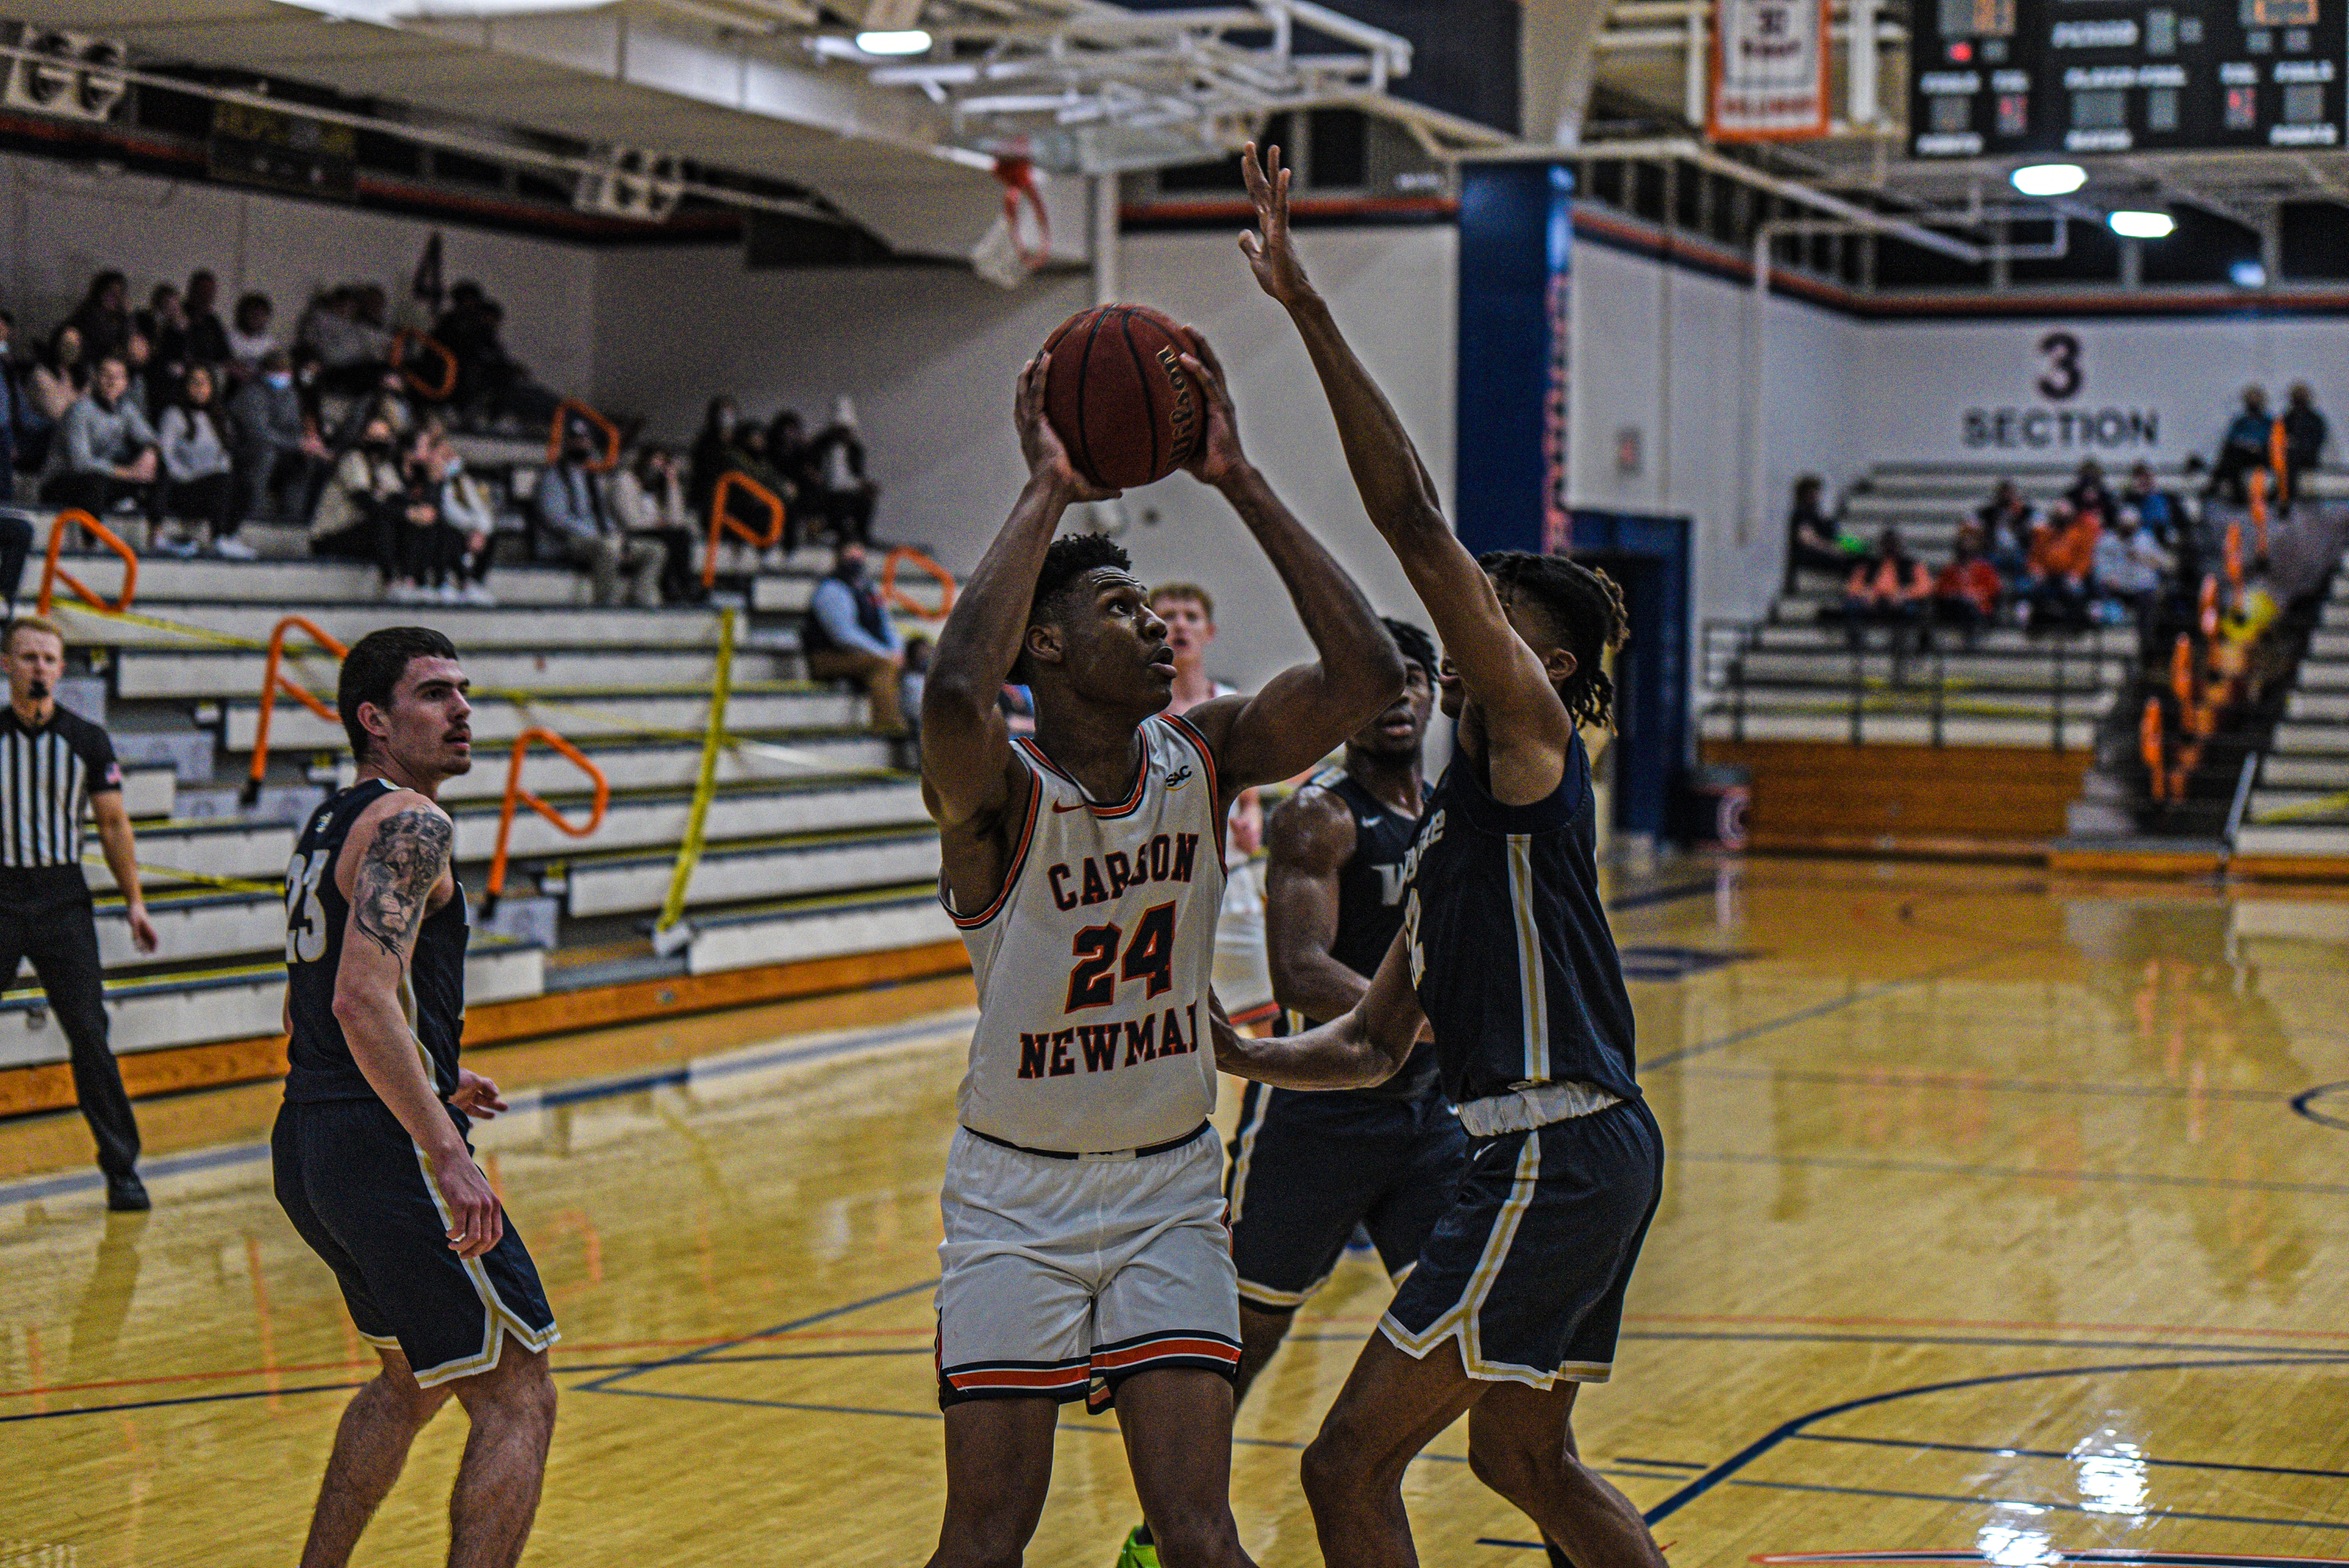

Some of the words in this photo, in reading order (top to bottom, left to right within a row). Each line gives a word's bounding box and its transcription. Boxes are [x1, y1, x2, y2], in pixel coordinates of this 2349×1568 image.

[2037, 331, 2083, 402] 3
[1962, 406, 2159, 449] SECTION
[1164, 764, 1193, 787] SAC
[285, 849, 330, 963] 23
[1047, 831, 1199, 911] CARSON
[1064, 900, 1177, 1014] 24
